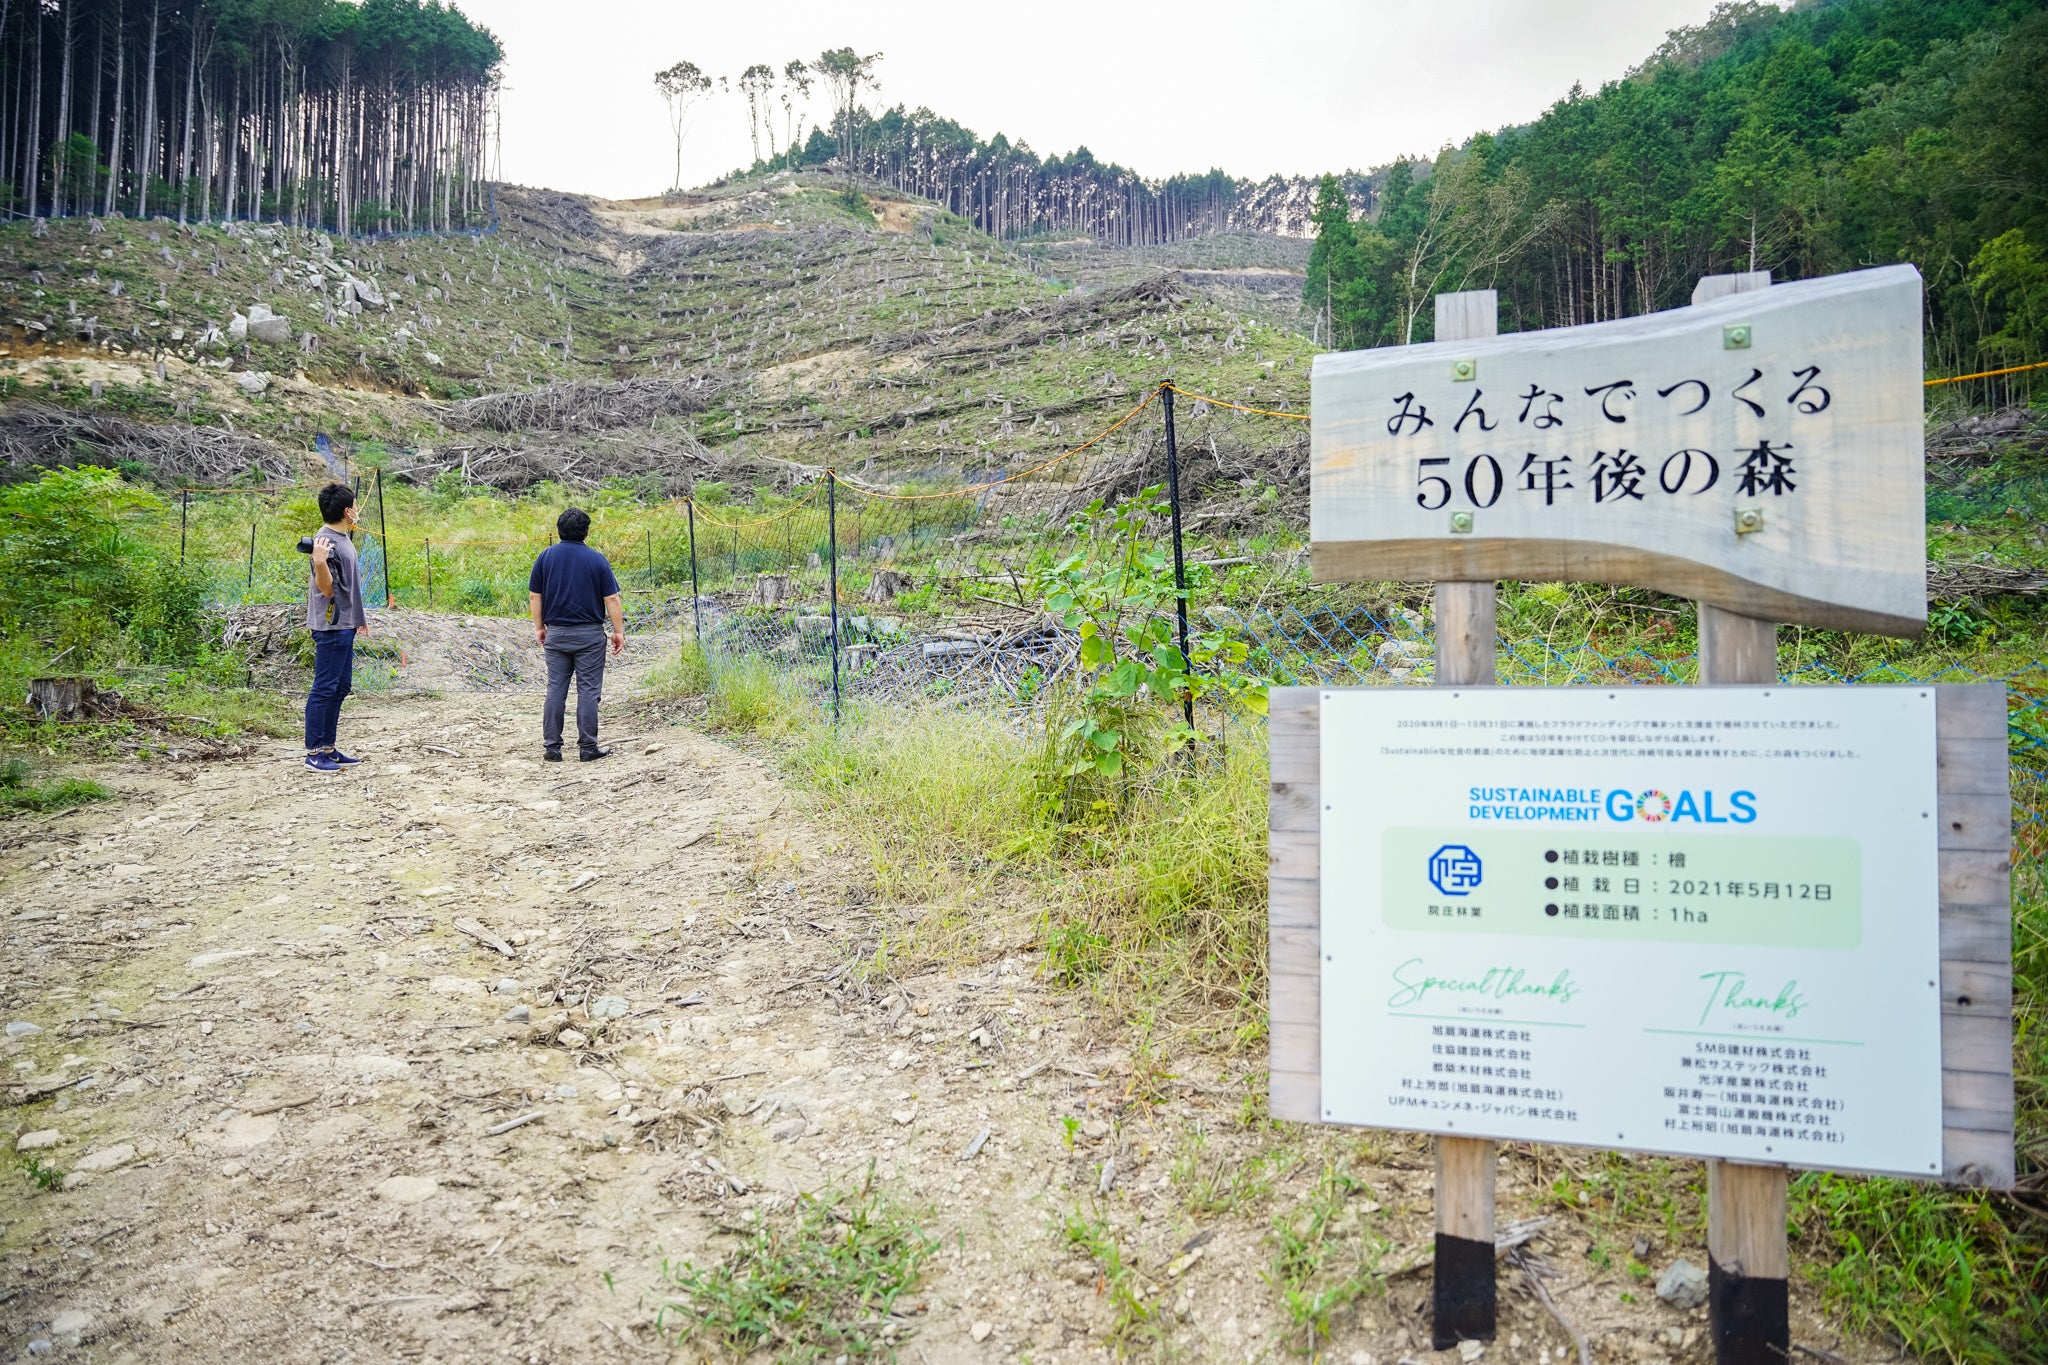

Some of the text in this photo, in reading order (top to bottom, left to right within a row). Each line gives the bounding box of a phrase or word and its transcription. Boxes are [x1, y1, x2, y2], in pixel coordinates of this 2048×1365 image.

[1386, 365, 1832, 436] みんなでつくる
[1415, 439, 1798, 510] 50年後の森
[1470, 787, 1757, 823] SUSTAINABLE GOALS
[1470, 806, 1601, 821] DEVELOPMENT
[1699, 971, 1808, 1026] Thanks
[1696, 1042, 1811, 1061] SMB建材株式会社
[1681, 1057, 1827, 1077] 兼松サステック株式会社
[1698, 1074, 1809, 1092] 光洋産業株式会社
